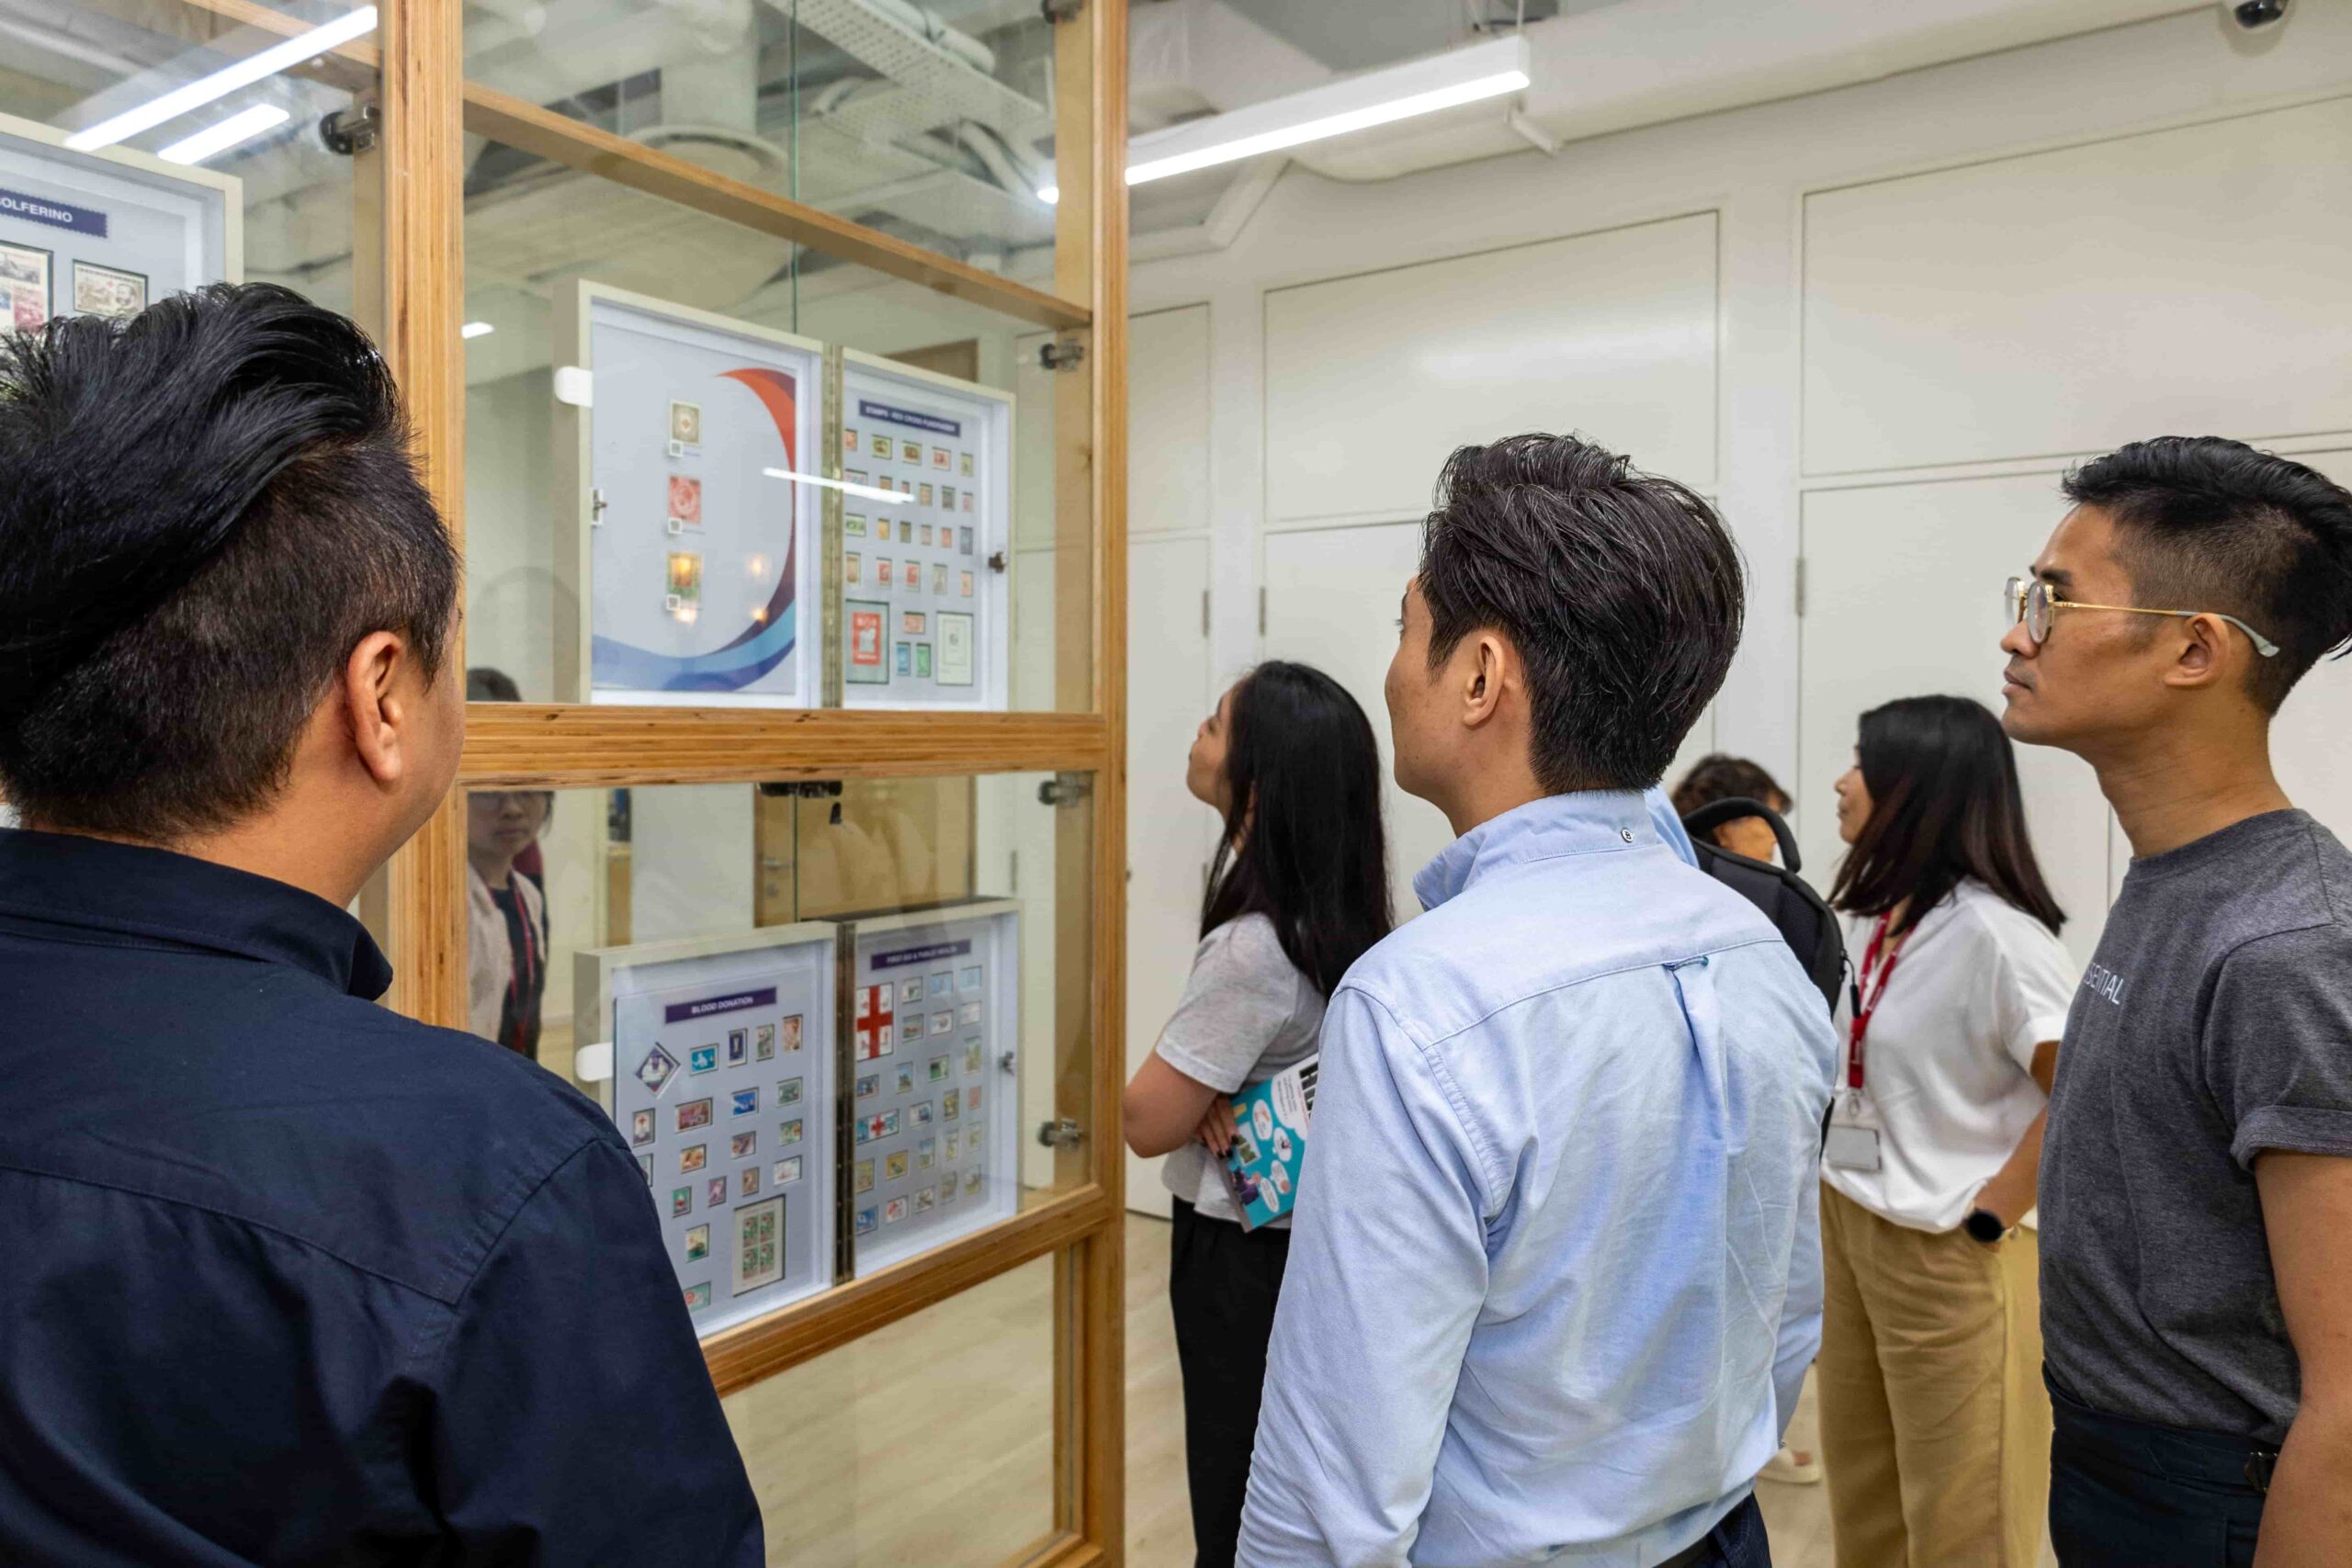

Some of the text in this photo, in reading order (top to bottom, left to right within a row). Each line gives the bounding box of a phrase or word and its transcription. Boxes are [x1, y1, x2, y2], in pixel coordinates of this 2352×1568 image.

[0, 197, 74, 222] OLFERINO
[691, 996, 753, 1014] BLOOD DONATION
